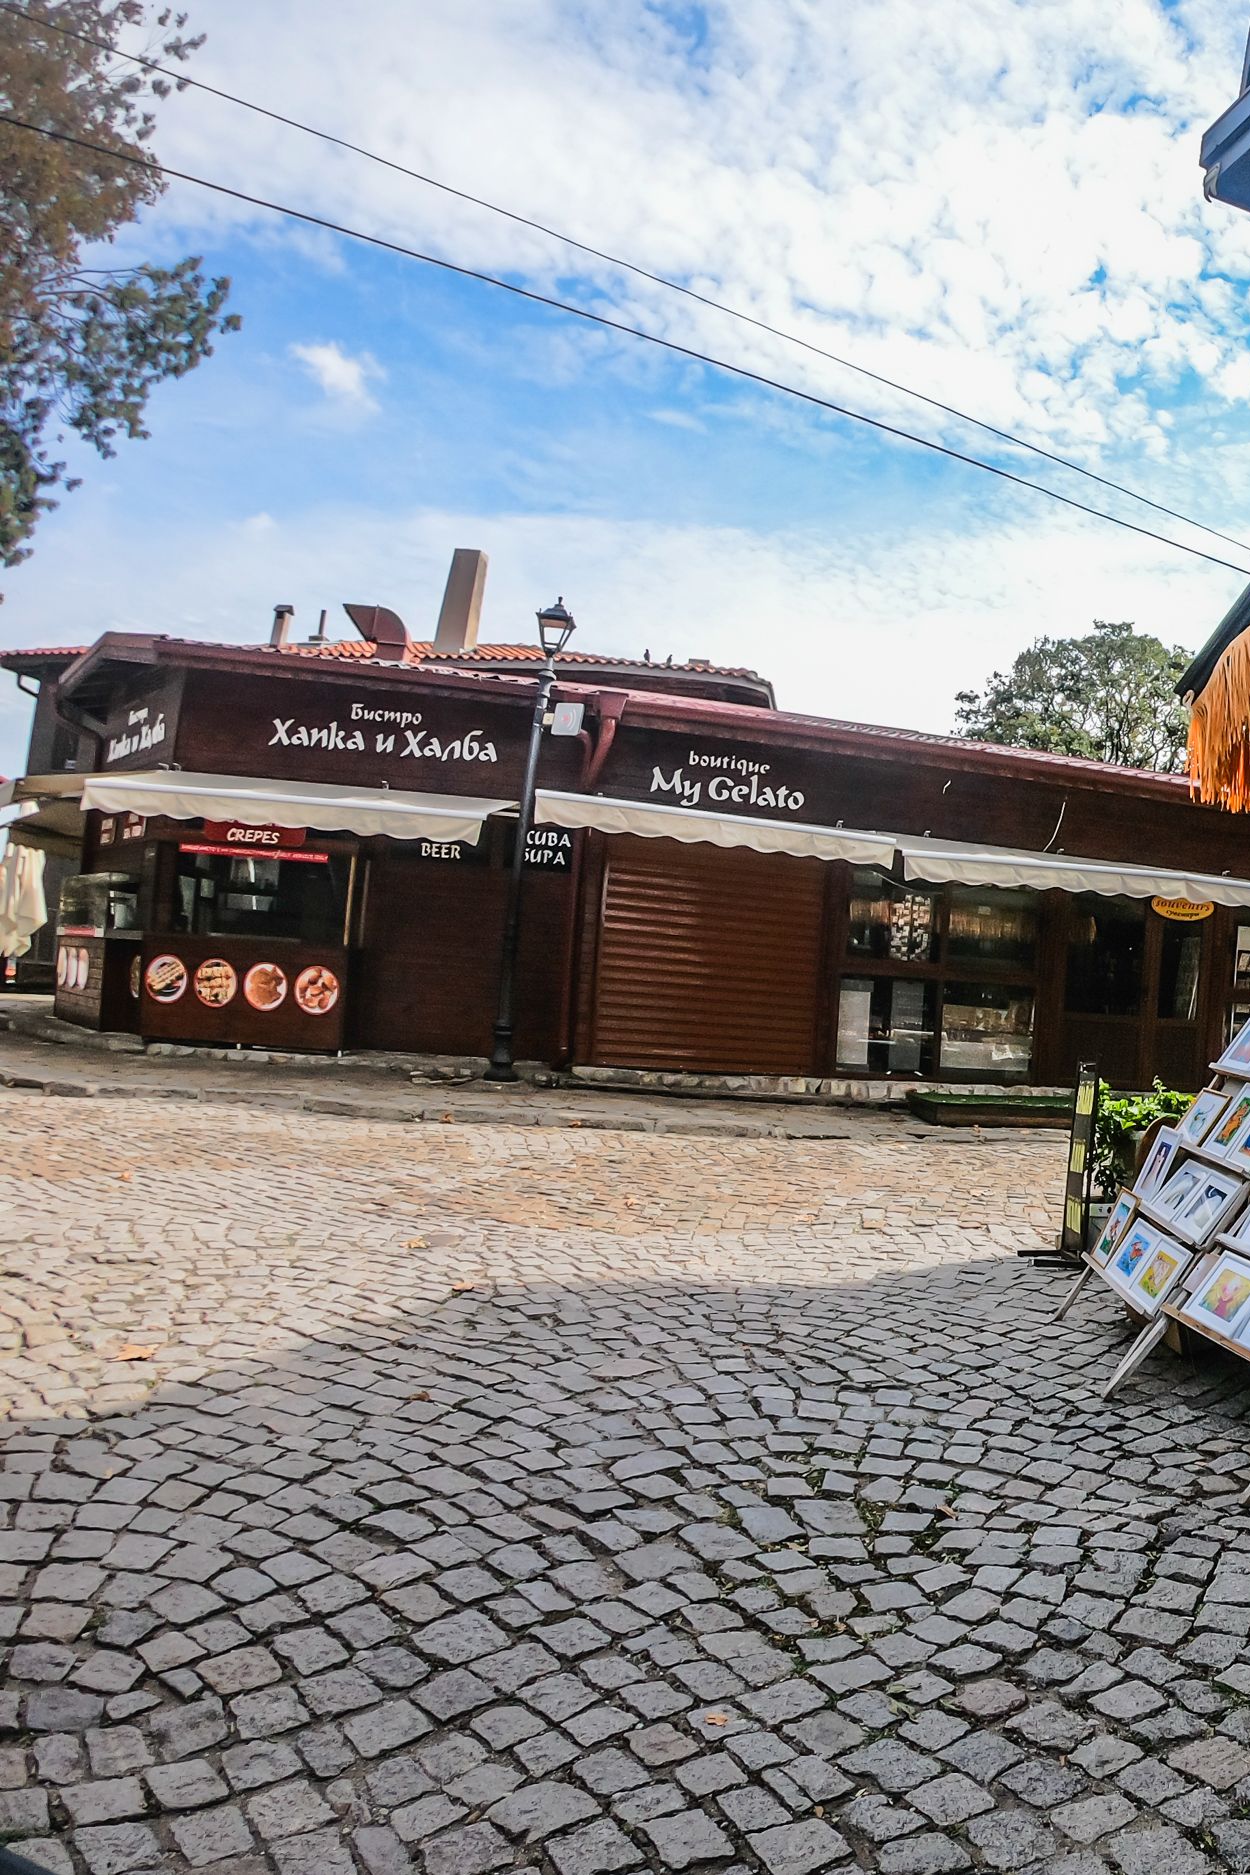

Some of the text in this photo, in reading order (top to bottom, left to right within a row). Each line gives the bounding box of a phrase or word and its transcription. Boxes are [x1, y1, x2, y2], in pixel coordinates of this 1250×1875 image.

[351, 703, 422, 728] Бистро
[268, 718, 498, 763] Хапка и Халба
[688, 750, 770, 776] boutique
[650, 766, 805, 810] My Gelato
[226, 827, 281, 844] CREPES
[420, 842, 462, 860] BEER
